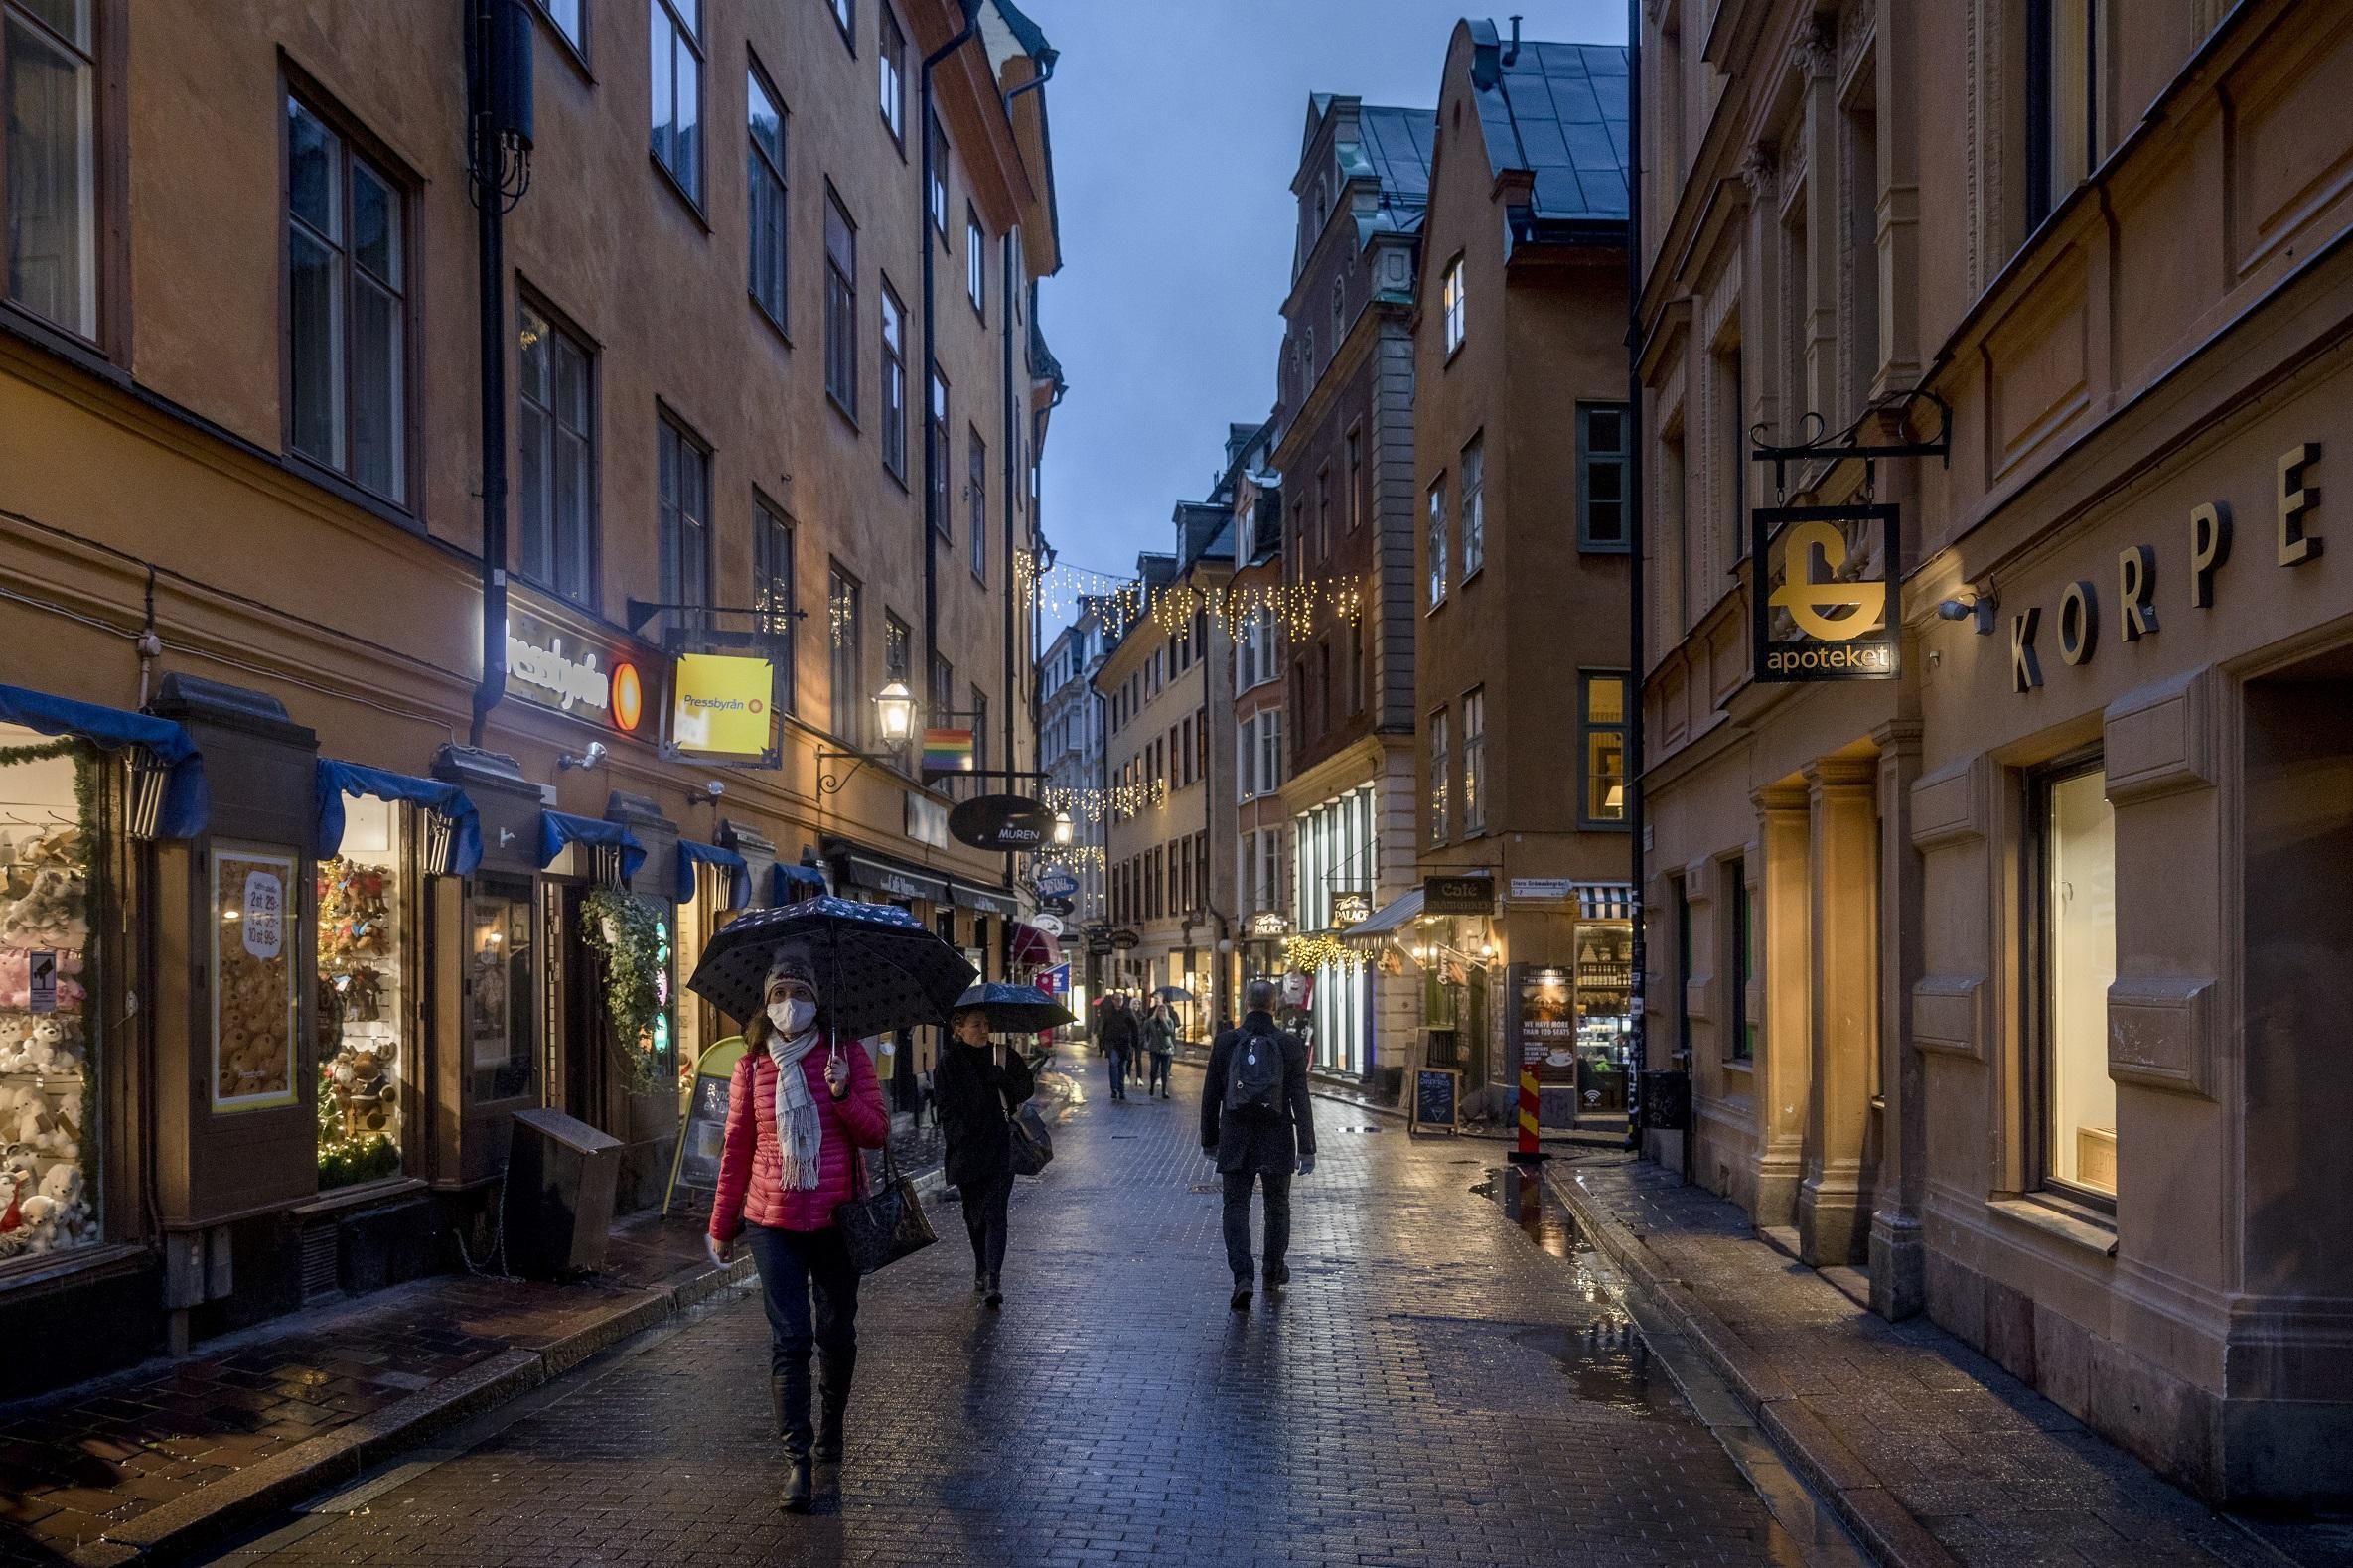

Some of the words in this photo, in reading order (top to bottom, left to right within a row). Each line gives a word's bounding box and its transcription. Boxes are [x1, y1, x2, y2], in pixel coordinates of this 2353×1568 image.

[2010, 443, 2324, 693] KORPE
[1768, 645, 1888, 674] apoteket
[683, 694, 744, 711] Pressbyrån
[998, 828, 1040, 840] MUREN
[1441, 882, 1478, 897] Café
[1334, 910, 1370, 922] PALACE
[1254, 925, 1284, 933] PALACE
